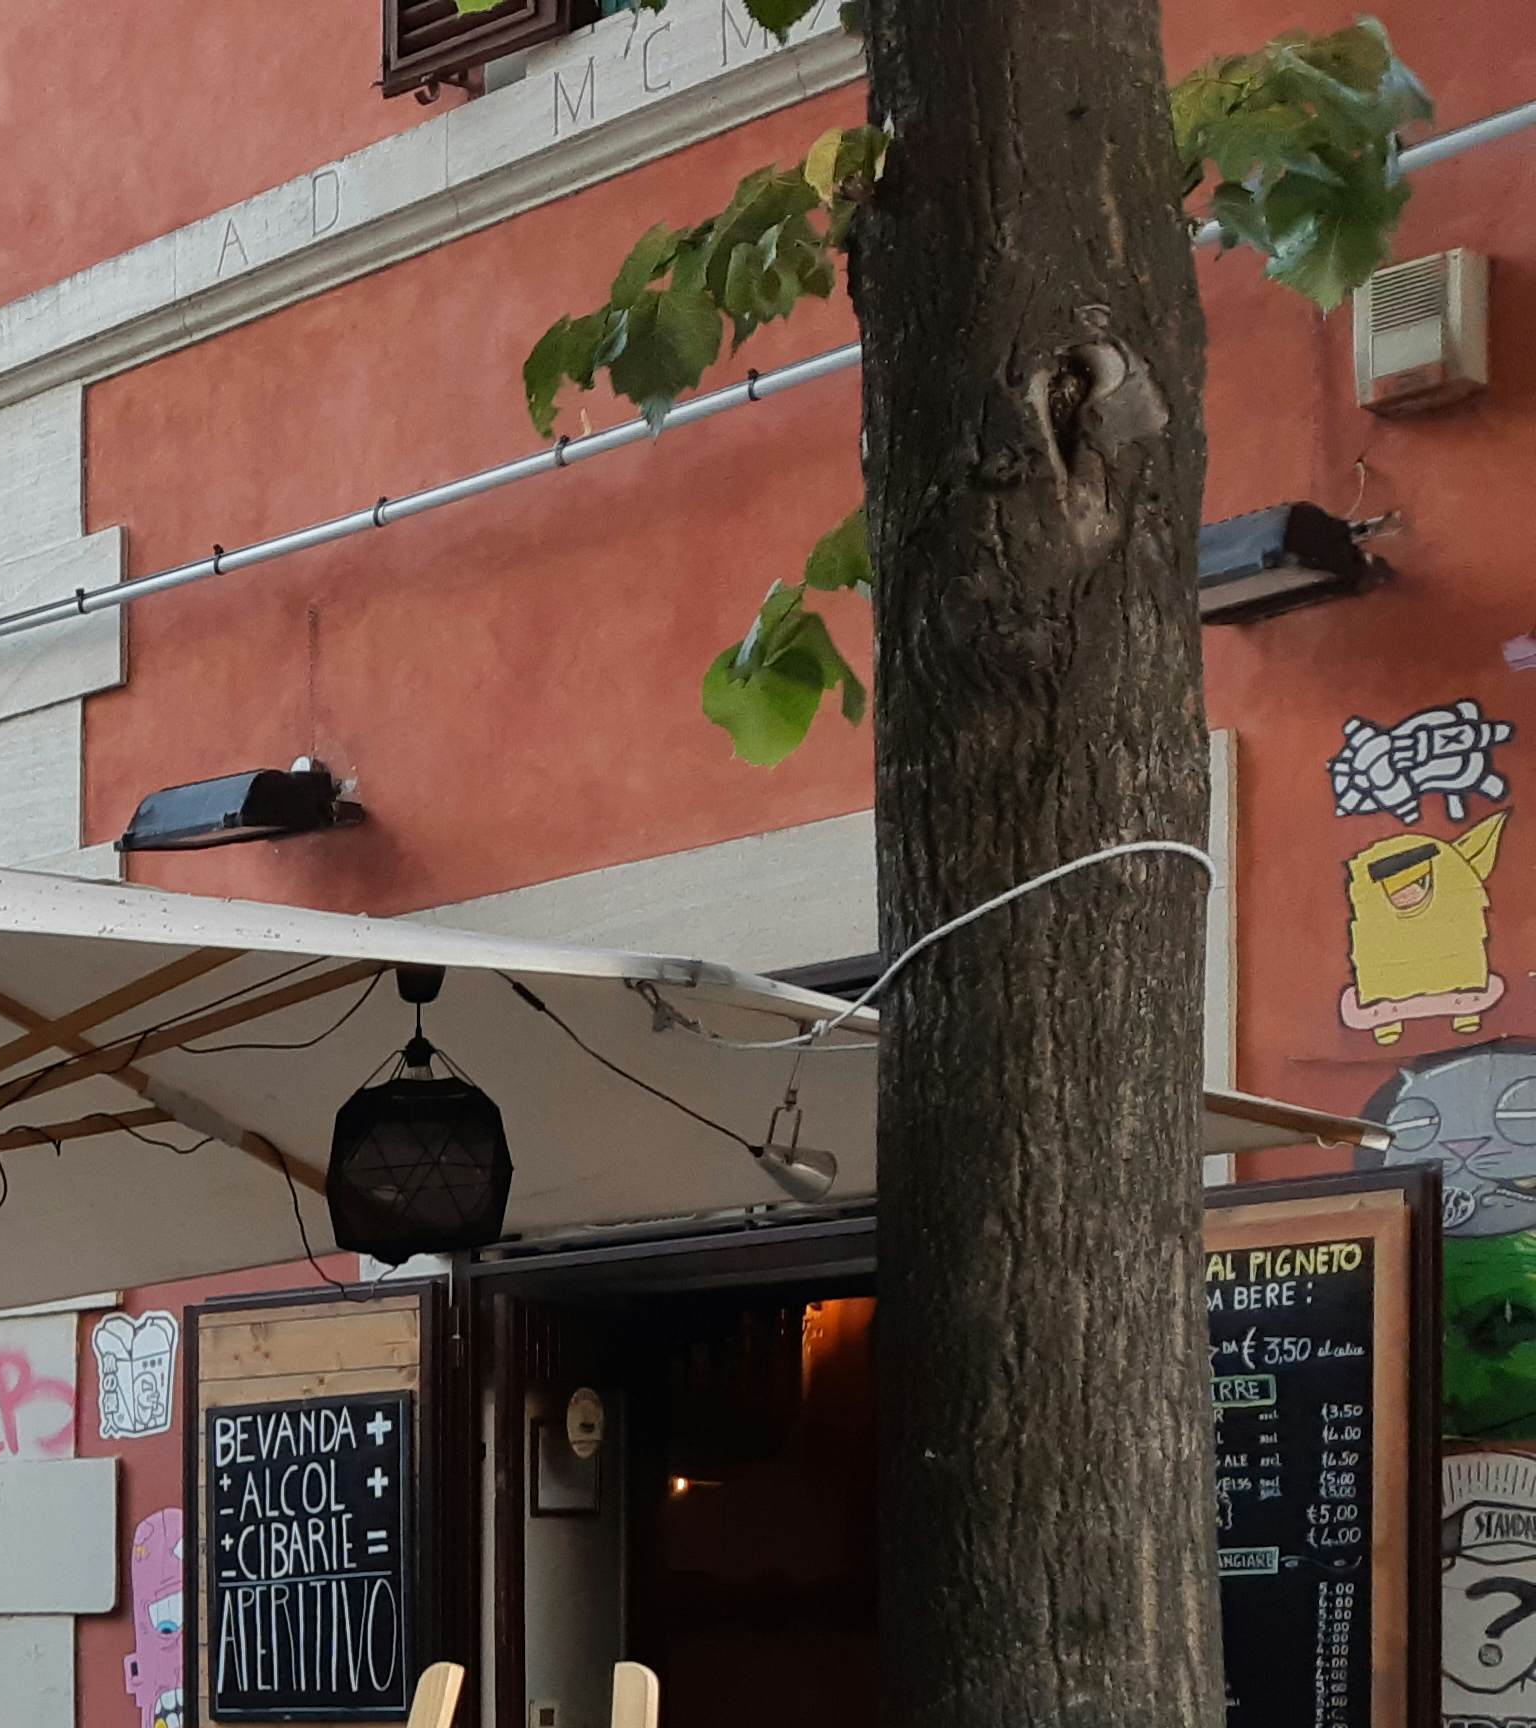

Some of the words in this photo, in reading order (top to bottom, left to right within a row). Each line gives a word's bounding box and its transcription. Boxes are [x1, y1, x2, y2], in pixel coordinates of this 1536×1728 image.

[1206, 1252, 1236, 1282] AL
[1249, 1243, 1363, 1282] PIGNETO
[1222, 1340, 1238, 1355] DA
[1211, 1380, 1260, 1401] IRRE
[215, 1405, 357, 1467] BEVANDA
[1224, 1454, 1249, 1468] ALE
[239, 1458, 346, 1522] ALCOL
[237, 1513, 357, 1581] CIBARIE
[217, 1578, 398, 1693] APERITIVO
